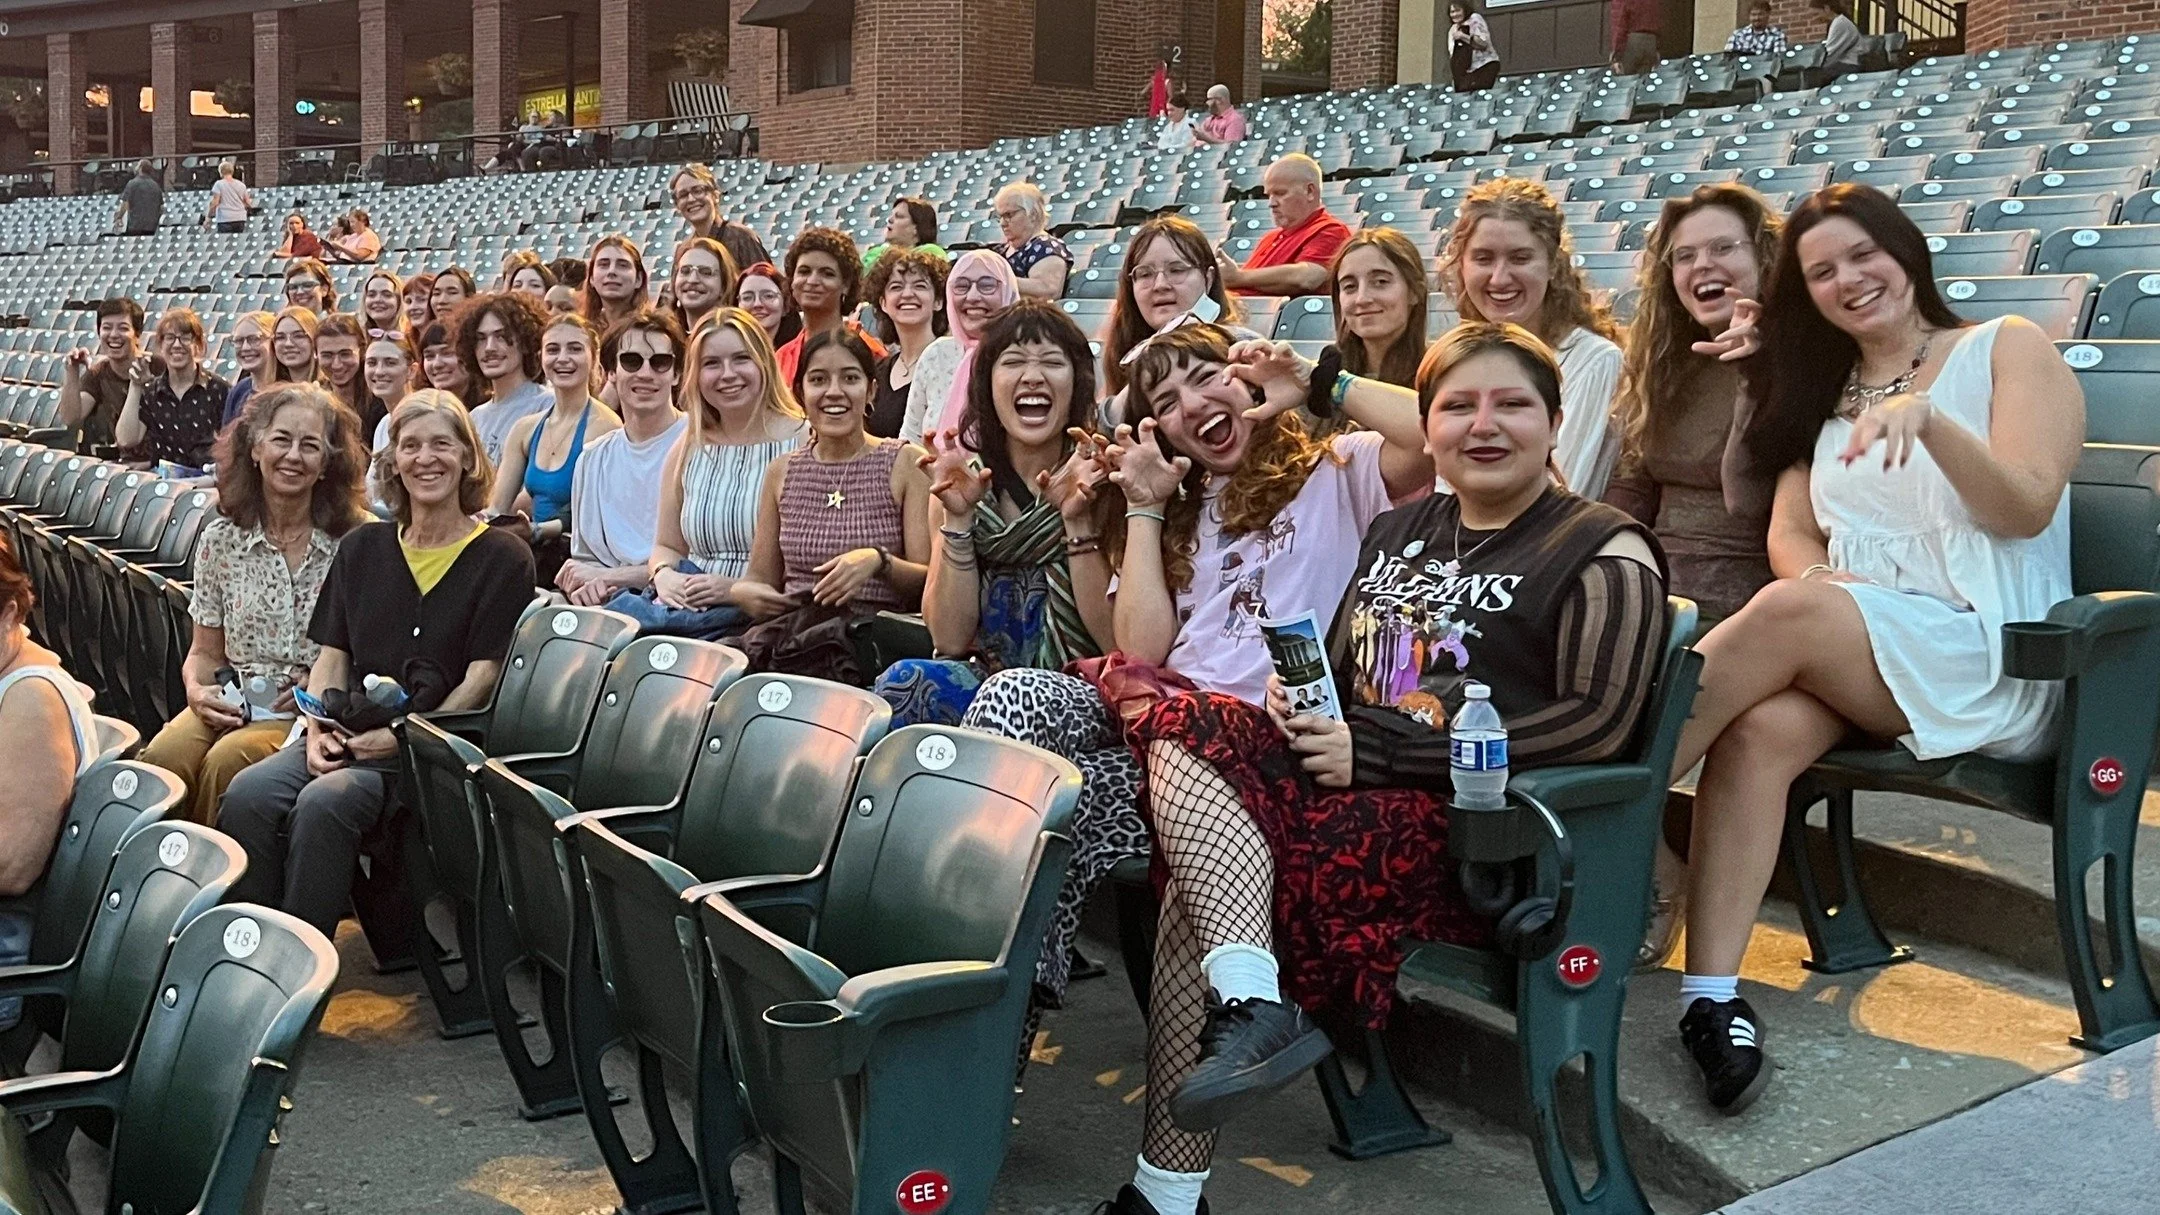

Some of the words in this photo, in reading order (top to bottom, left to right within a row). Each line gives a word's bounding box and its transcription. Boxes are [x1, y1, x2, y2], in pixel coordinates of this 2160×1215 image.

[1172, 45, 1182, 63] 2
[525, 93, 567, 113] ESTRELLA
[574, 88, 601, 107] ANTI
[2074, 351, 2092, 362] 18
[559, 617, 572, 629] 15
[656, 647, 671, 662] 16
[766, 690, 784, 703] 17
[927, 744, 945, 761] 18
[2097, 767, 2117, 783] GG
[165, 842, 182, 858] 17
[231, 928, 252, 948] 18
[1570, 956, 1588, 974] FF
[912, 1182, 937, 1203] EE
